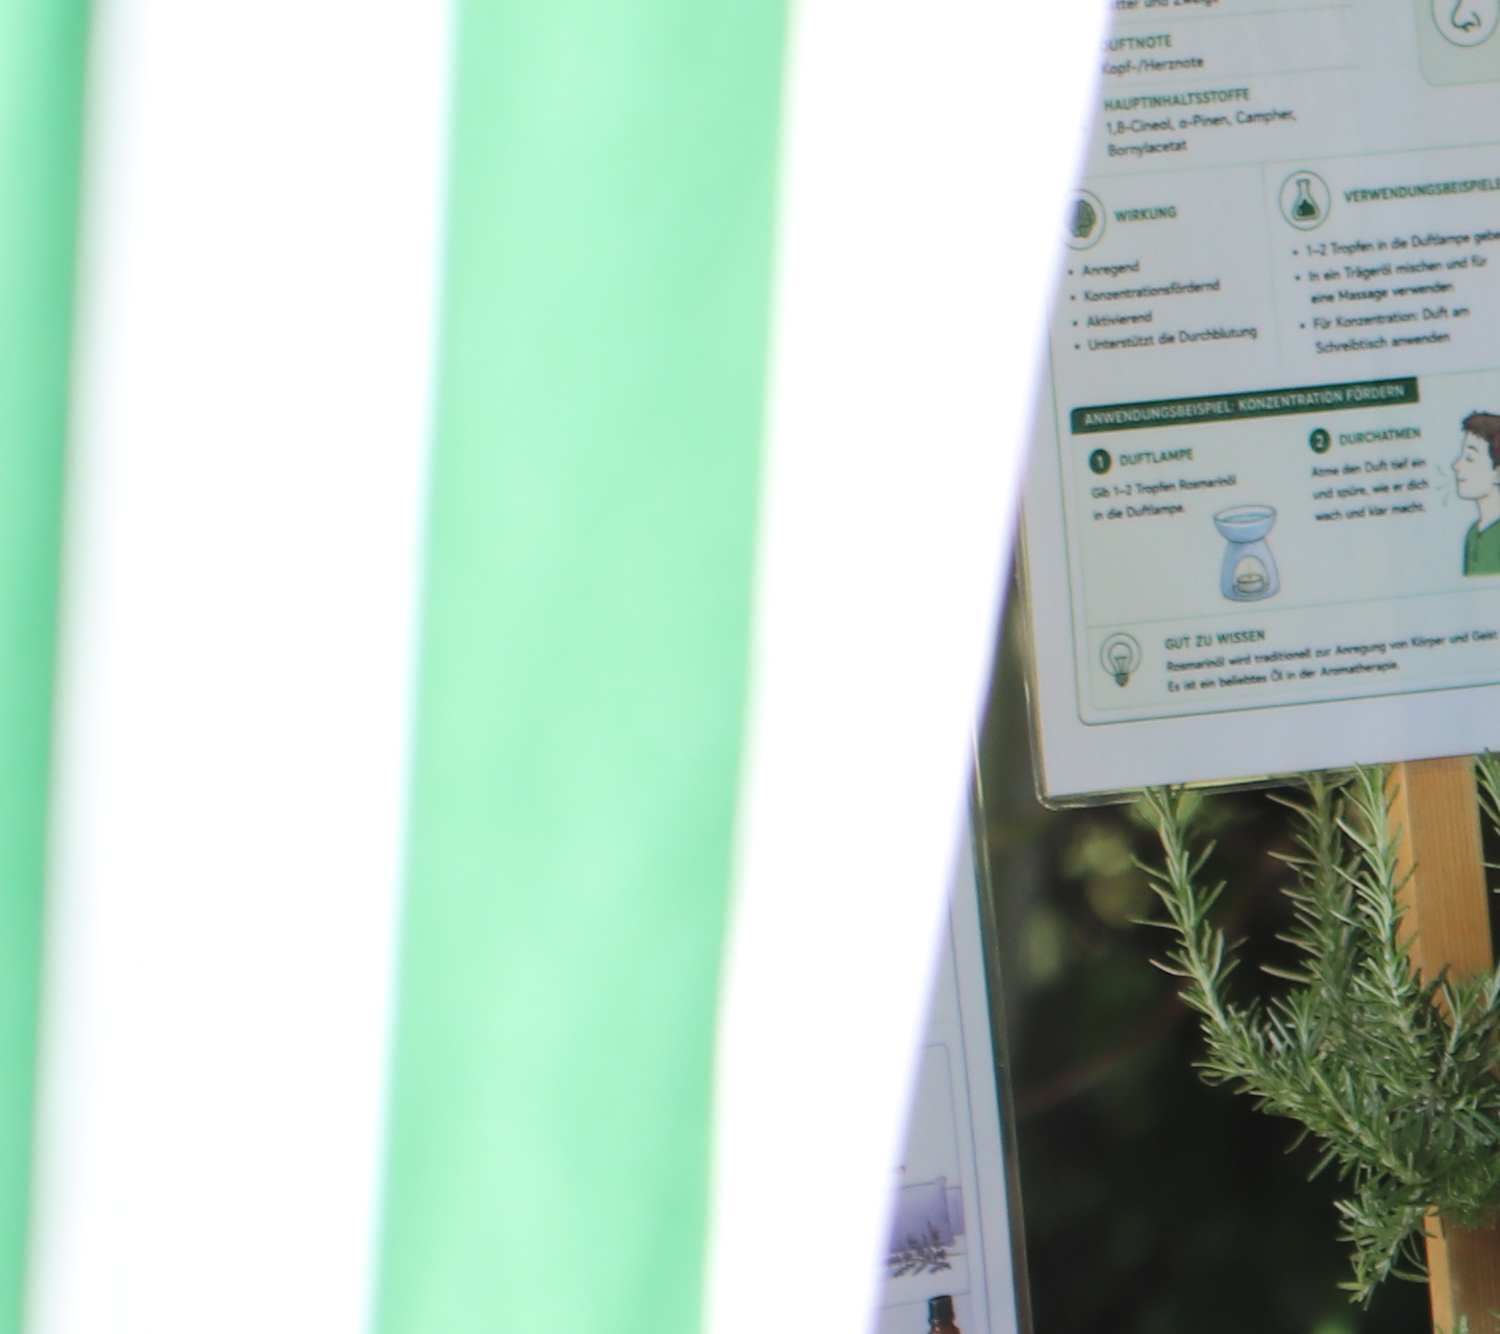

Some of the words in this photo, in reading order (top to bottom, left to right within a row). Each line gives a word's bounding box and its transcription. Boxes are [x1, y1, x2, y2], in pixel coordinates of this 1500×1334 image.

[1103, 87, 1250, 113] HAUPTINHALTSSTOFFE
[1114, 205, 1177, 223] WIRKUNG
[1237, 388, 1344, 412] KONZENTRATION
[1344, 382, 1404, 402] FÖRDERN
[1338, 425, 1421, 446] DURCHATMEN
[1119, 447, 1193, 467] DUFTLAMPE
[1163, 635, 1191, 651] GUT
[1194, 633, 1213, 648] ZU
[1216, 628, 1265, 646] WISSEN
